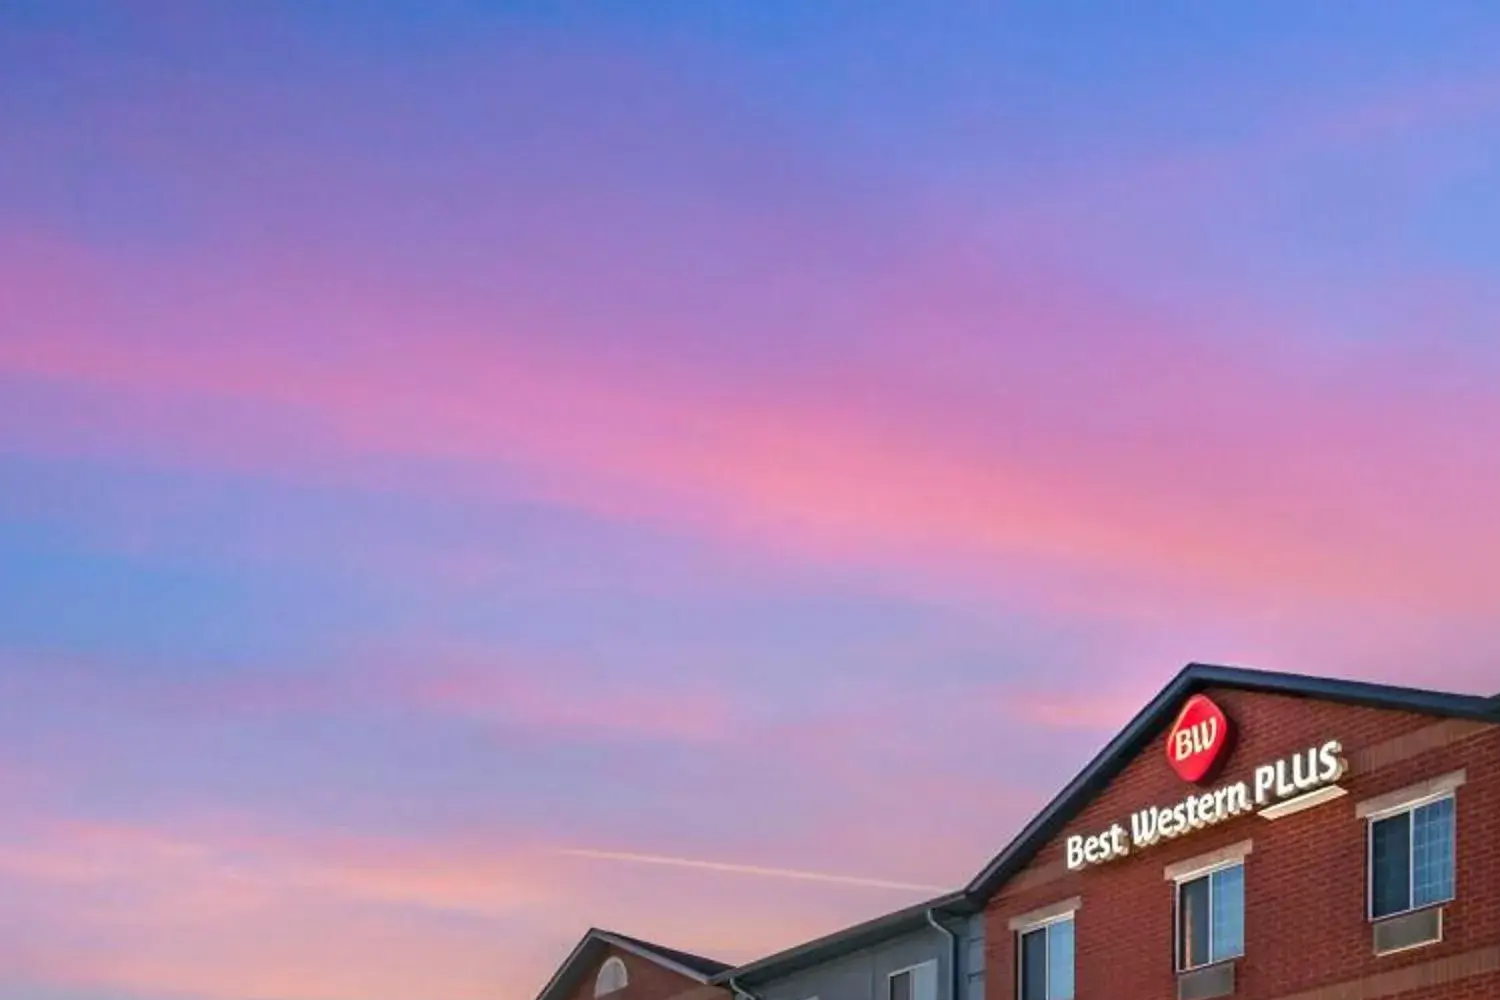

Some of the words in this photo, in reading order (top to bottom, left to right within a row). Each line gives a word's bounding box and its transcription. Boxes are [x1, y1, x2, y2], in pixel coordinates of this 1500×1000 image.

[1175, 716, 1217, 761] BW
[1067, 824, 1128, 869] Best
[1131, 781, 1252, 846] Western
[1255, 740, 1344, 803] PLUS
